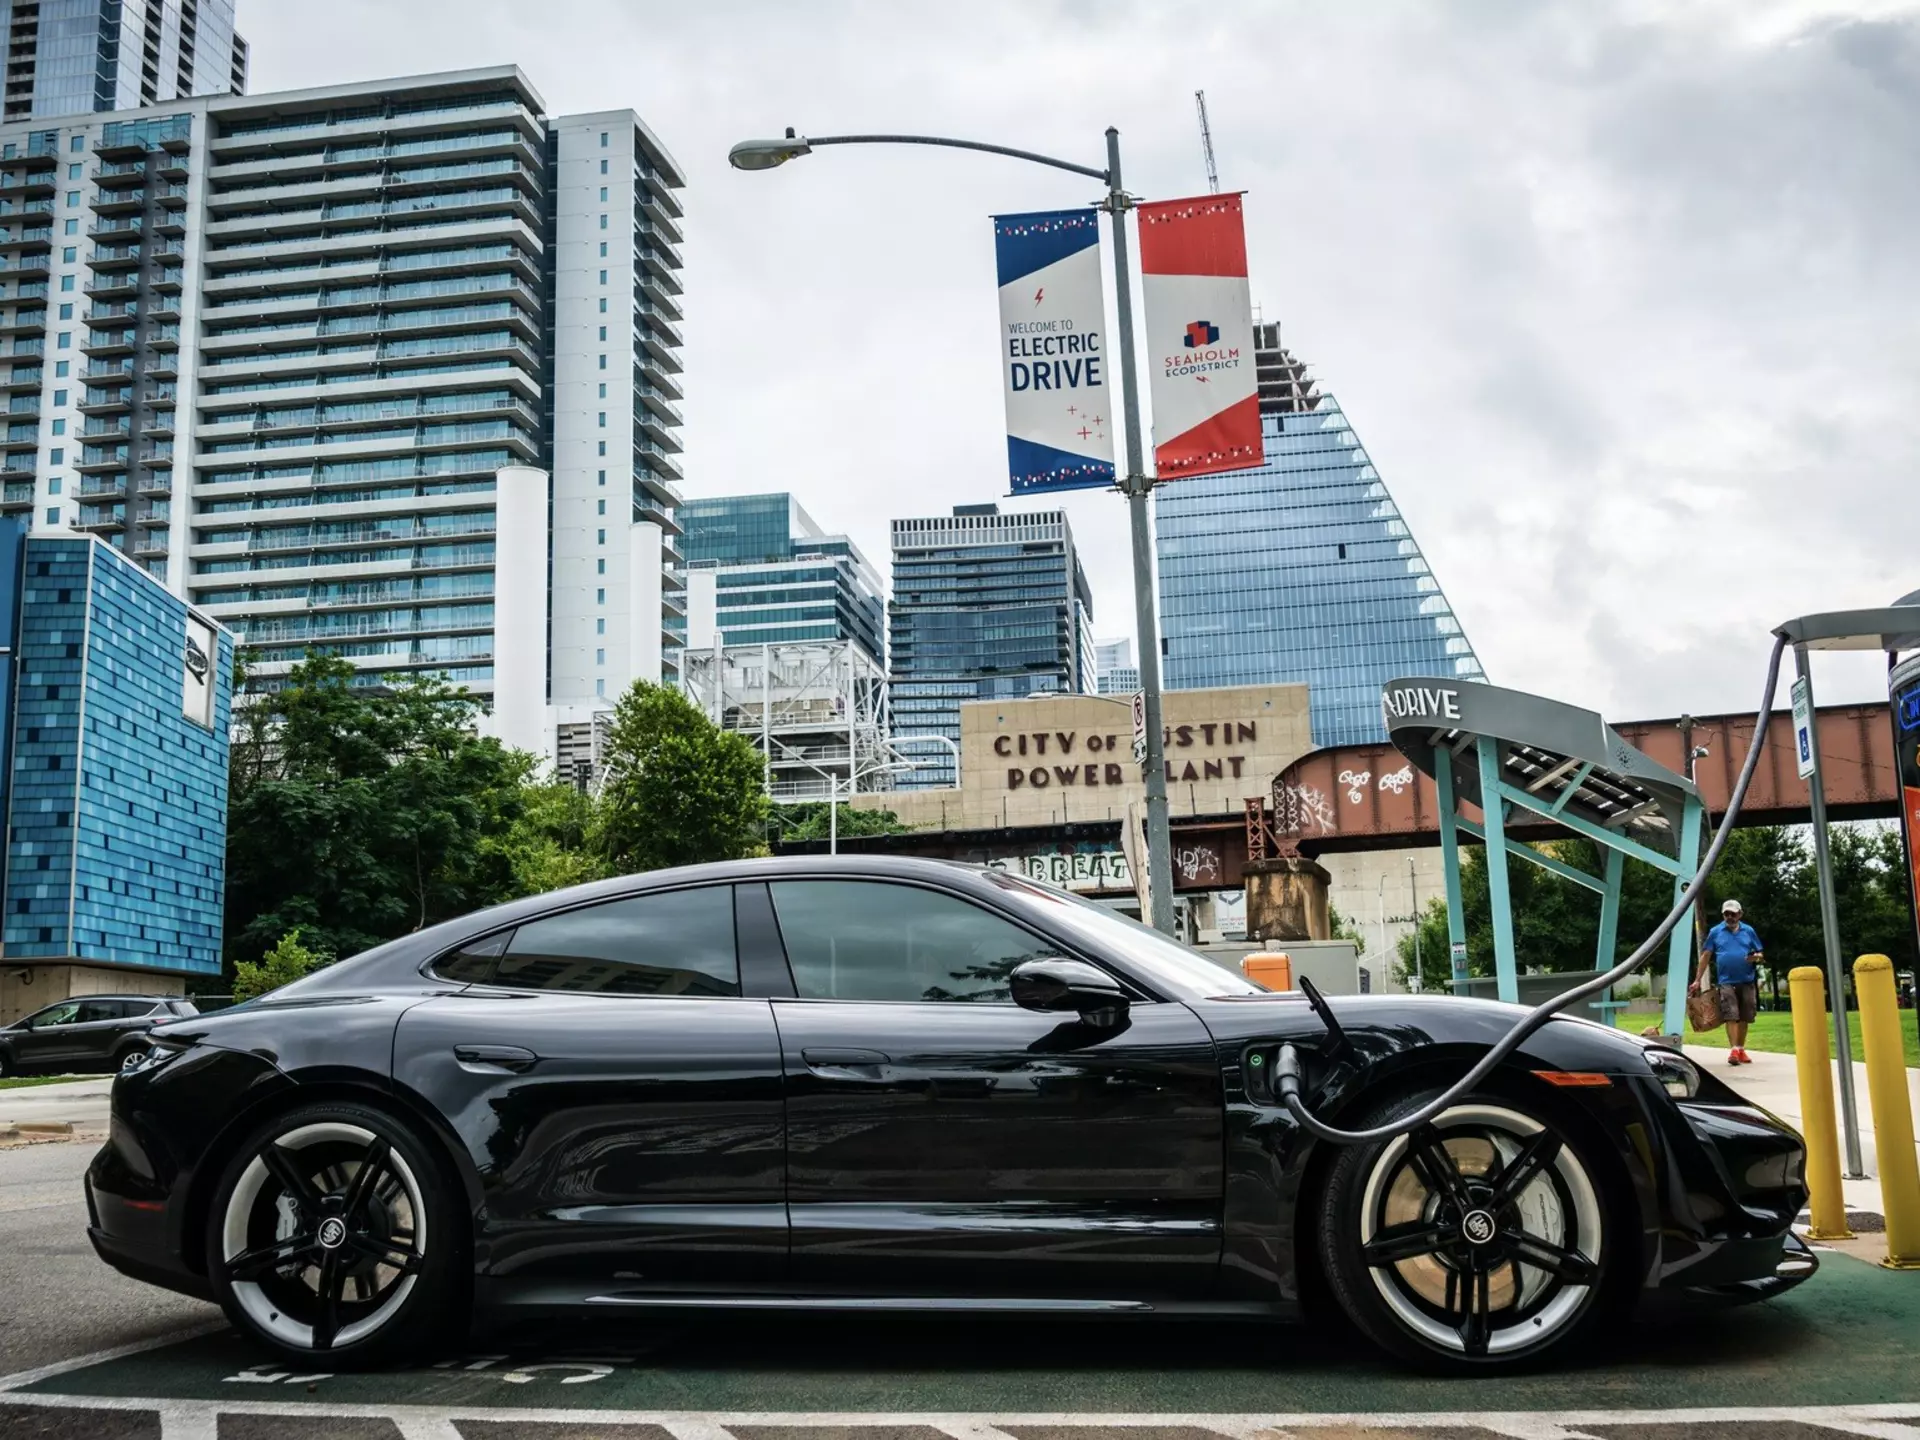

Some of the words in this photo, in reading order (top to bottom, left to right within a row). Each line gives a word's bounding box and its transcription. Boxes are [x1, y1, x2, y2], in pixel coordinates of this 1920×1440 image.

[1008, 320, 1058, 334] WELCOME
[1059, 319, 1073, 331] TO
[1009, 332, 1100, 357] ELECTRIC
[1165, 347, 1239, 368] SEAHOLM
[1011, 356, 1103, 392] DRIVE
[1165, 359, 1240, 378] ECODISTRICT
[1394, 687, 1461, 720] DRIVE
[994, 731, 1076, 757] CITY
[1086, 734, 1117, 752] OF
[1131, 720, 1257, 749] STIN
[1007, 763, 1123, 790] POWER
[1029, 854, 1129, 883] BREAT
